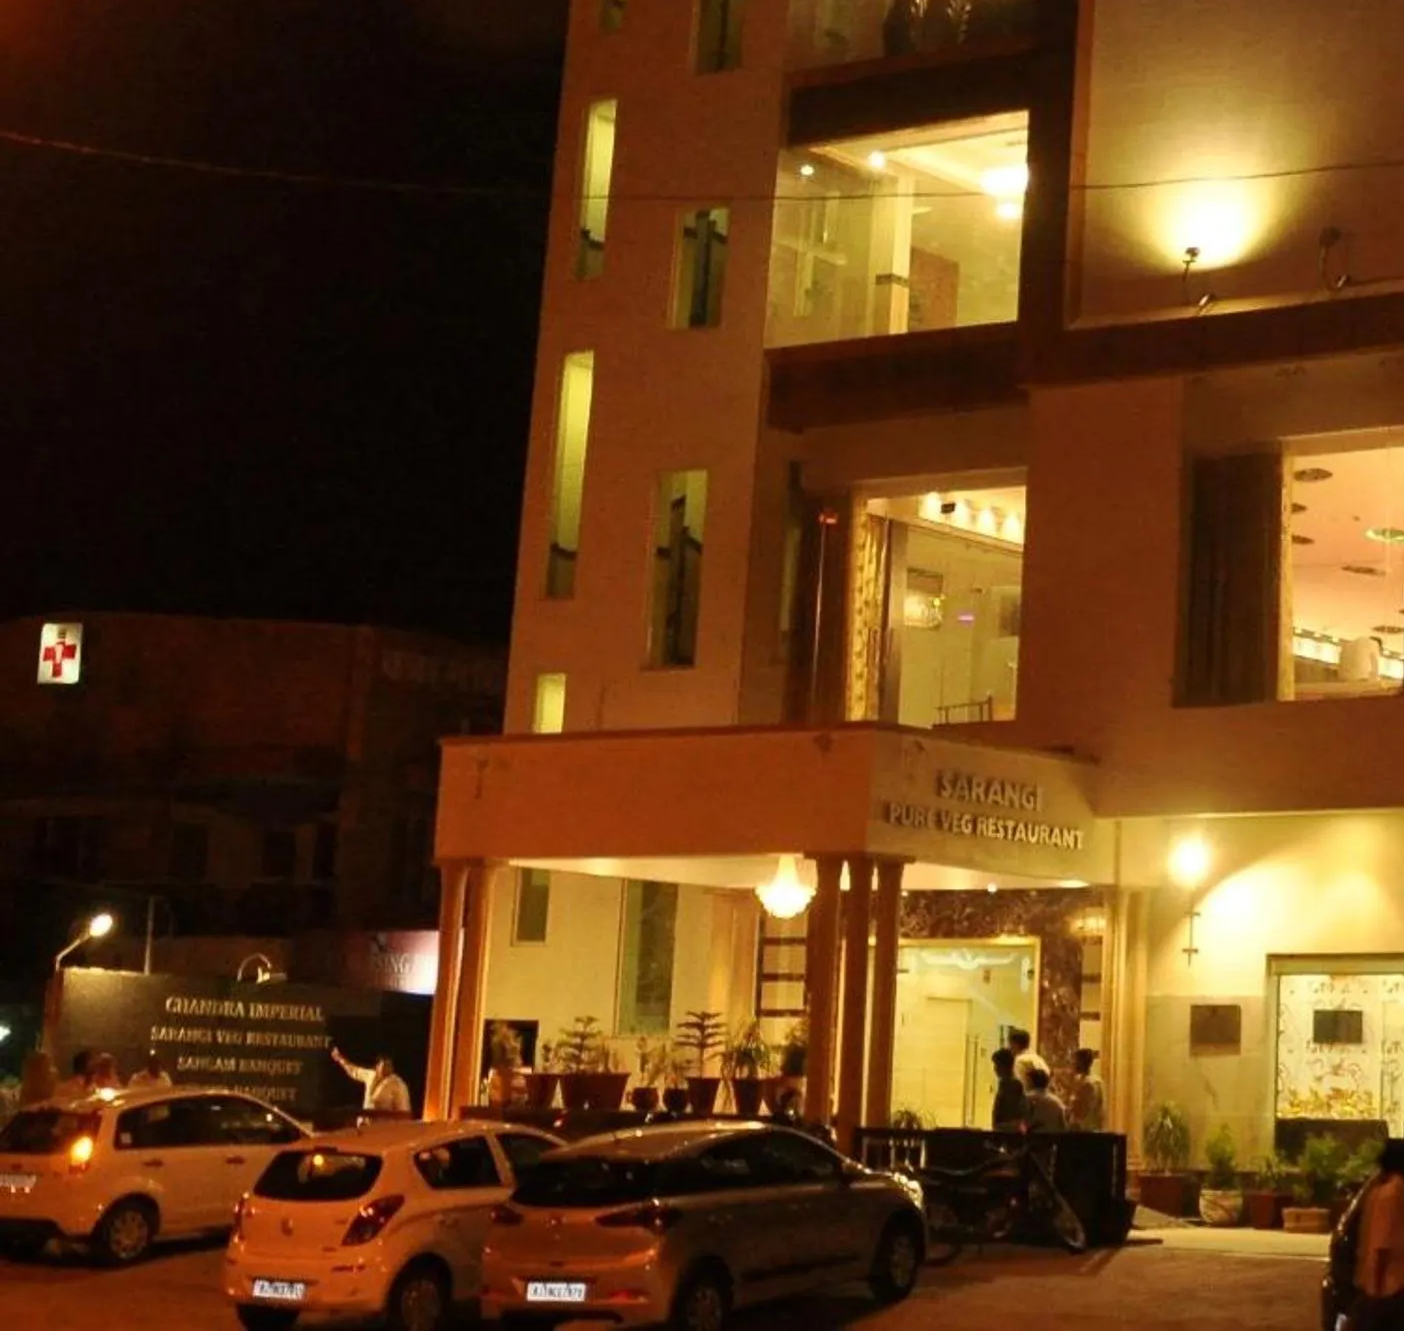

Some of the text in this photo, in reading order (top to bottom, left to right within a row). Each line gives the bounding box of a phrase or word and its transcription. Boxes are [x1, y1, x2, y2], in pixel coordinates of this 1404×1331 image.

[939, 774, 1044, 812] SARANGI
[888, 801, 1085, 851] PURE VEG RESTAURANT
[165, 995, 326, 1022] CHANDRA IMPERIAL
[215, 1028, 243, 1045] VEG
[246, 1031, 333, 1049] RESTAURANT
